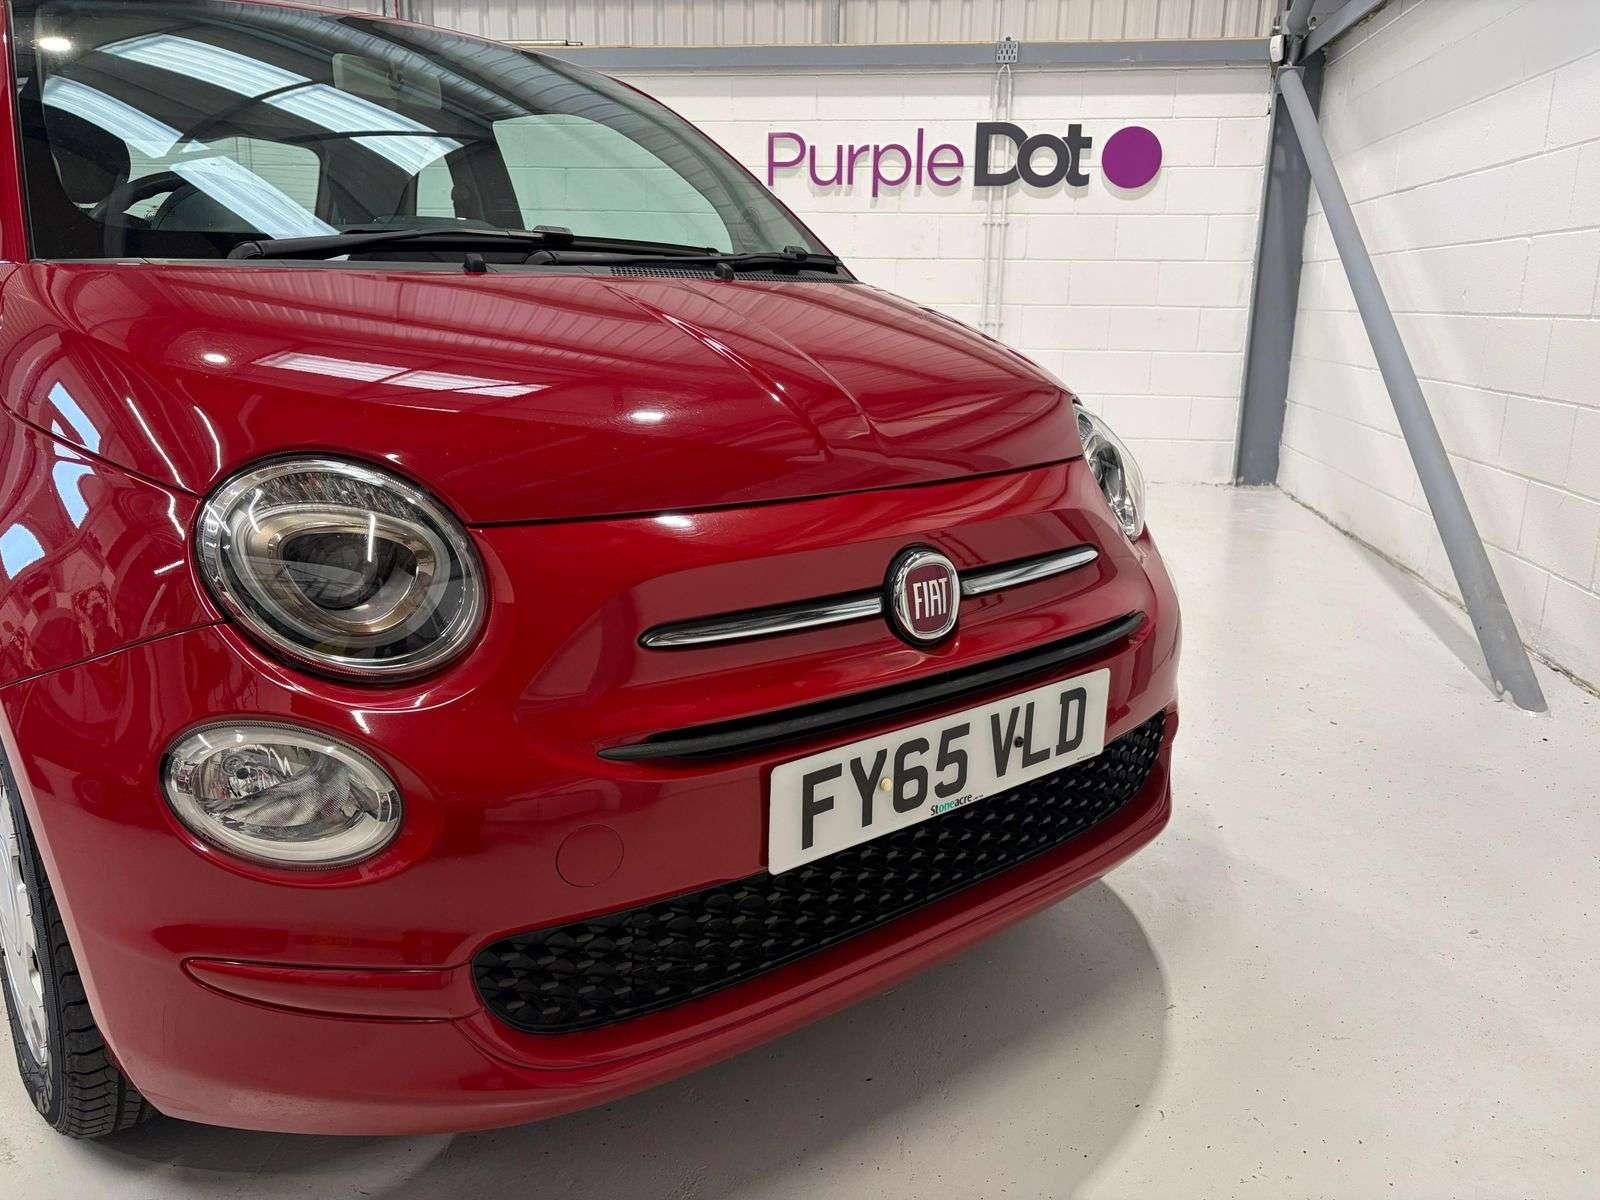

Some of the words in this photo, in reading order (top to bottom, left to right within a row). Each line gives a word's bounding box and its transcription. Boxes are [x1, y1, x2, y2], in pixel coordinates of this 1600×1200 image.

[767, 128, 964, 198] Purple
[974, 122, 1093, 188] Dot
[913, 578, 948, 620] FIAT
[801, 722, 970, 851] FY65
[990, 686, 1087, 778] VLD
[930, 794, 973, 816] Stoneacre
